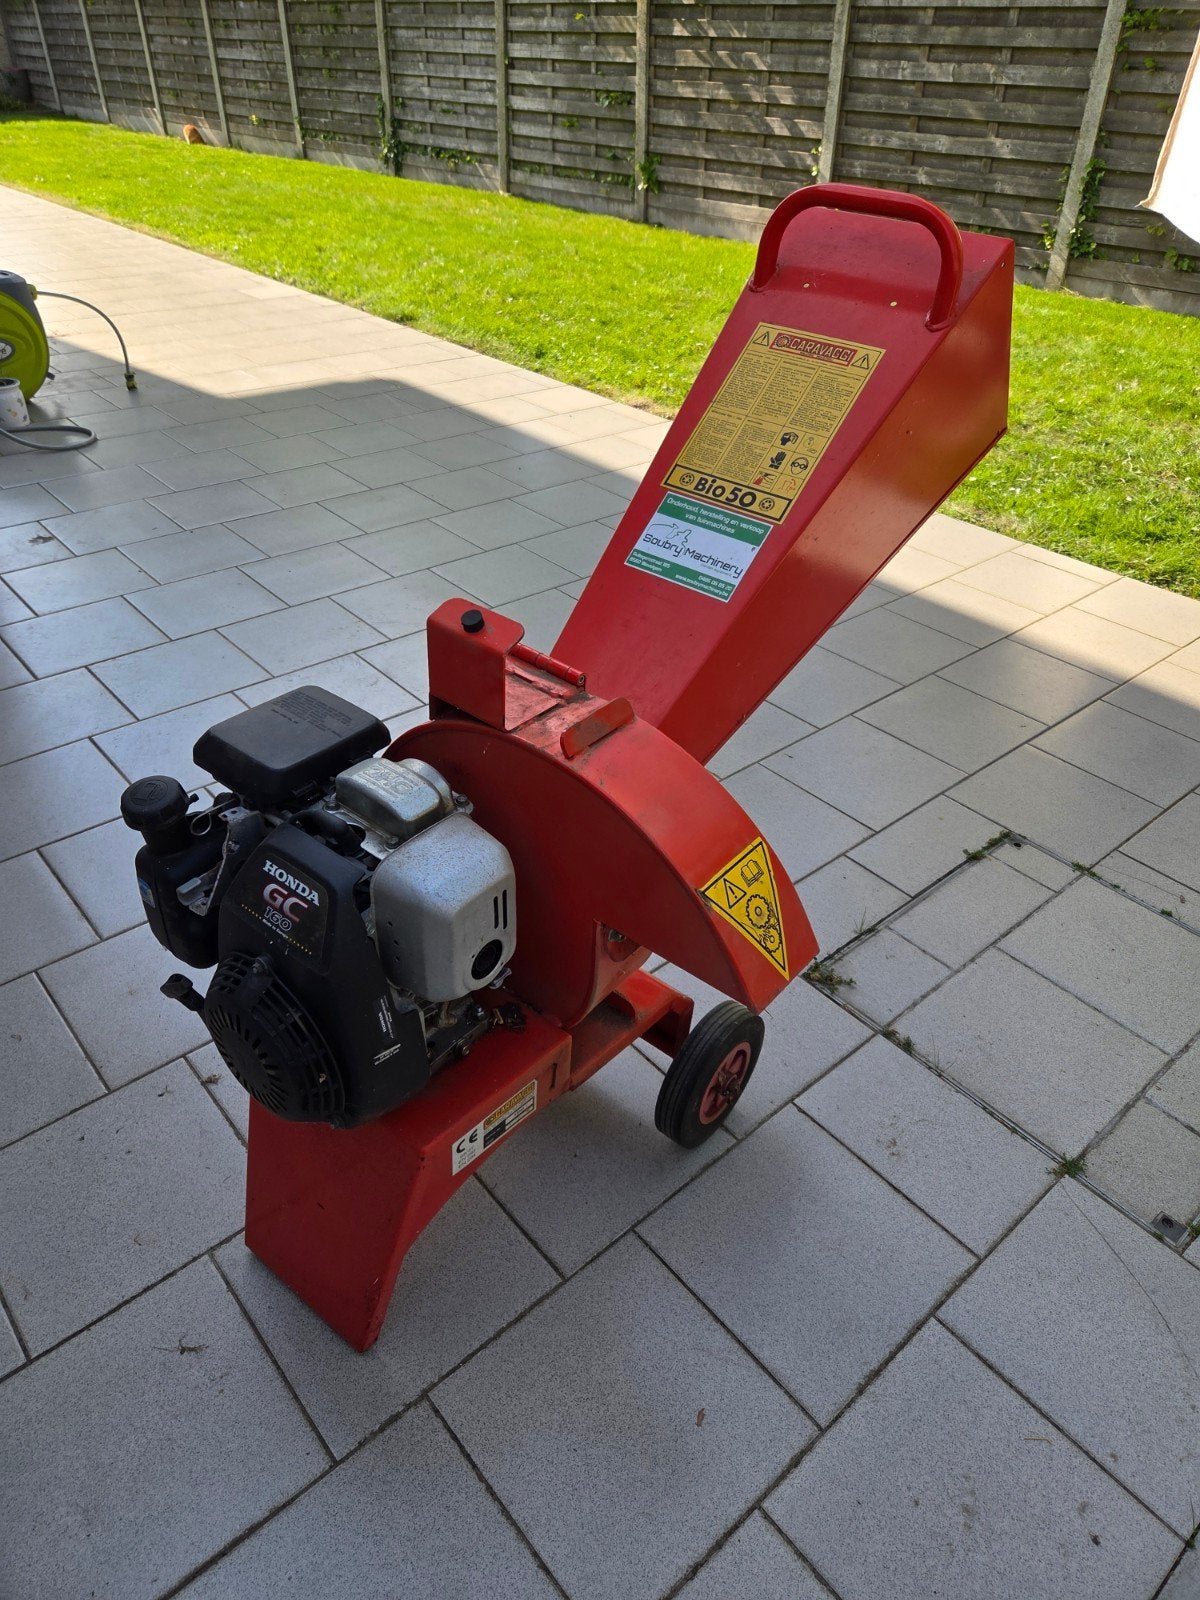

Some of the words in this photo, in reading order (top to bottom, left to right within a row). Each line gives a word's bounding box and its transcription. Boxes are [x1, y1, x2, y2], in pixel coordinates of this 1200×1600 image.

[790, 338, 854, 362] CARAVAGGI
[693, 476, 726, 498] Bio
[725, 487, 757, 508] 50
[685, 513, 697, 521] van
[697, 516, 736, 534] tuinmachines
[699, 508, 731, 524] herstelling
[740, 522, 765, 535] verkoop
[643, 533, 684, 558] Soubry
[684, 547, 744, 579] Machinery
[263, 860, 320, 907] HONDA
[263, 883, 308, 922] GC
[264, 906, 292, 932] 160
